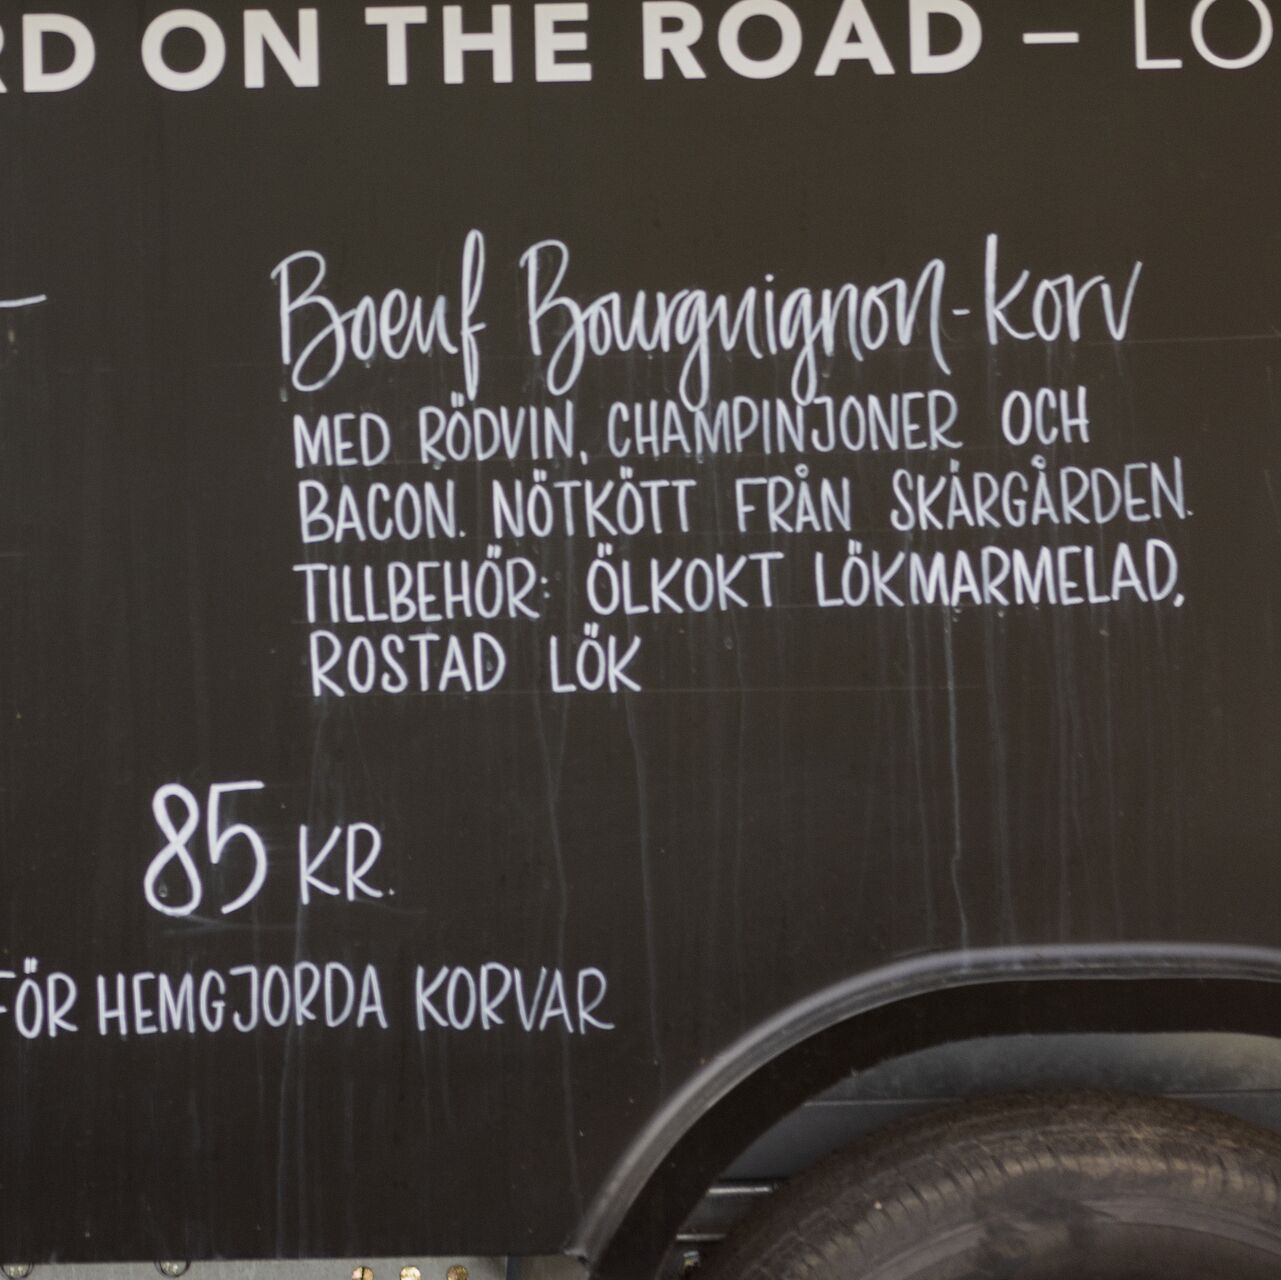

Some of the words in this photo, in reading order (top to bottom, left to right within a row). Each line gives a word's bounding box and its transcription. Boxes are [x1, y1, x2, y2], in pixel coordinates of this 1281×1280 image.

[142, 9, 319, 91] ON
[365, 3, 591, 85] THE
[271, 229, 486, 404] Boeuf
[294, 413, 390, 468] MED
[419, 392, 587, 470] RÖDVIN,
[608, 390, 962, 457] CHAMPINJONER
[1002, 386, 1089, 445] OCH
[299, 479, 465, 543] BACON.
[493, 466, 696, 539] NÖTKÖTT
[736, 464, 851, 533] FRÅN
[891, 455, 1192, 531] SKÄRGÅRDEN.
[293, 544, 549, 623] TILLBEHÖR:
[587, 543, 784, 615] ÖLKOKT
[310, 630, 506, 697] ROSTAD
[550, 622, 641, 693] LÖK
[144, 781, 267, 916] 85
[97, 962, 387, 1035] HEMGJORDA
[416, 963, 614, 1033] KORVAR
